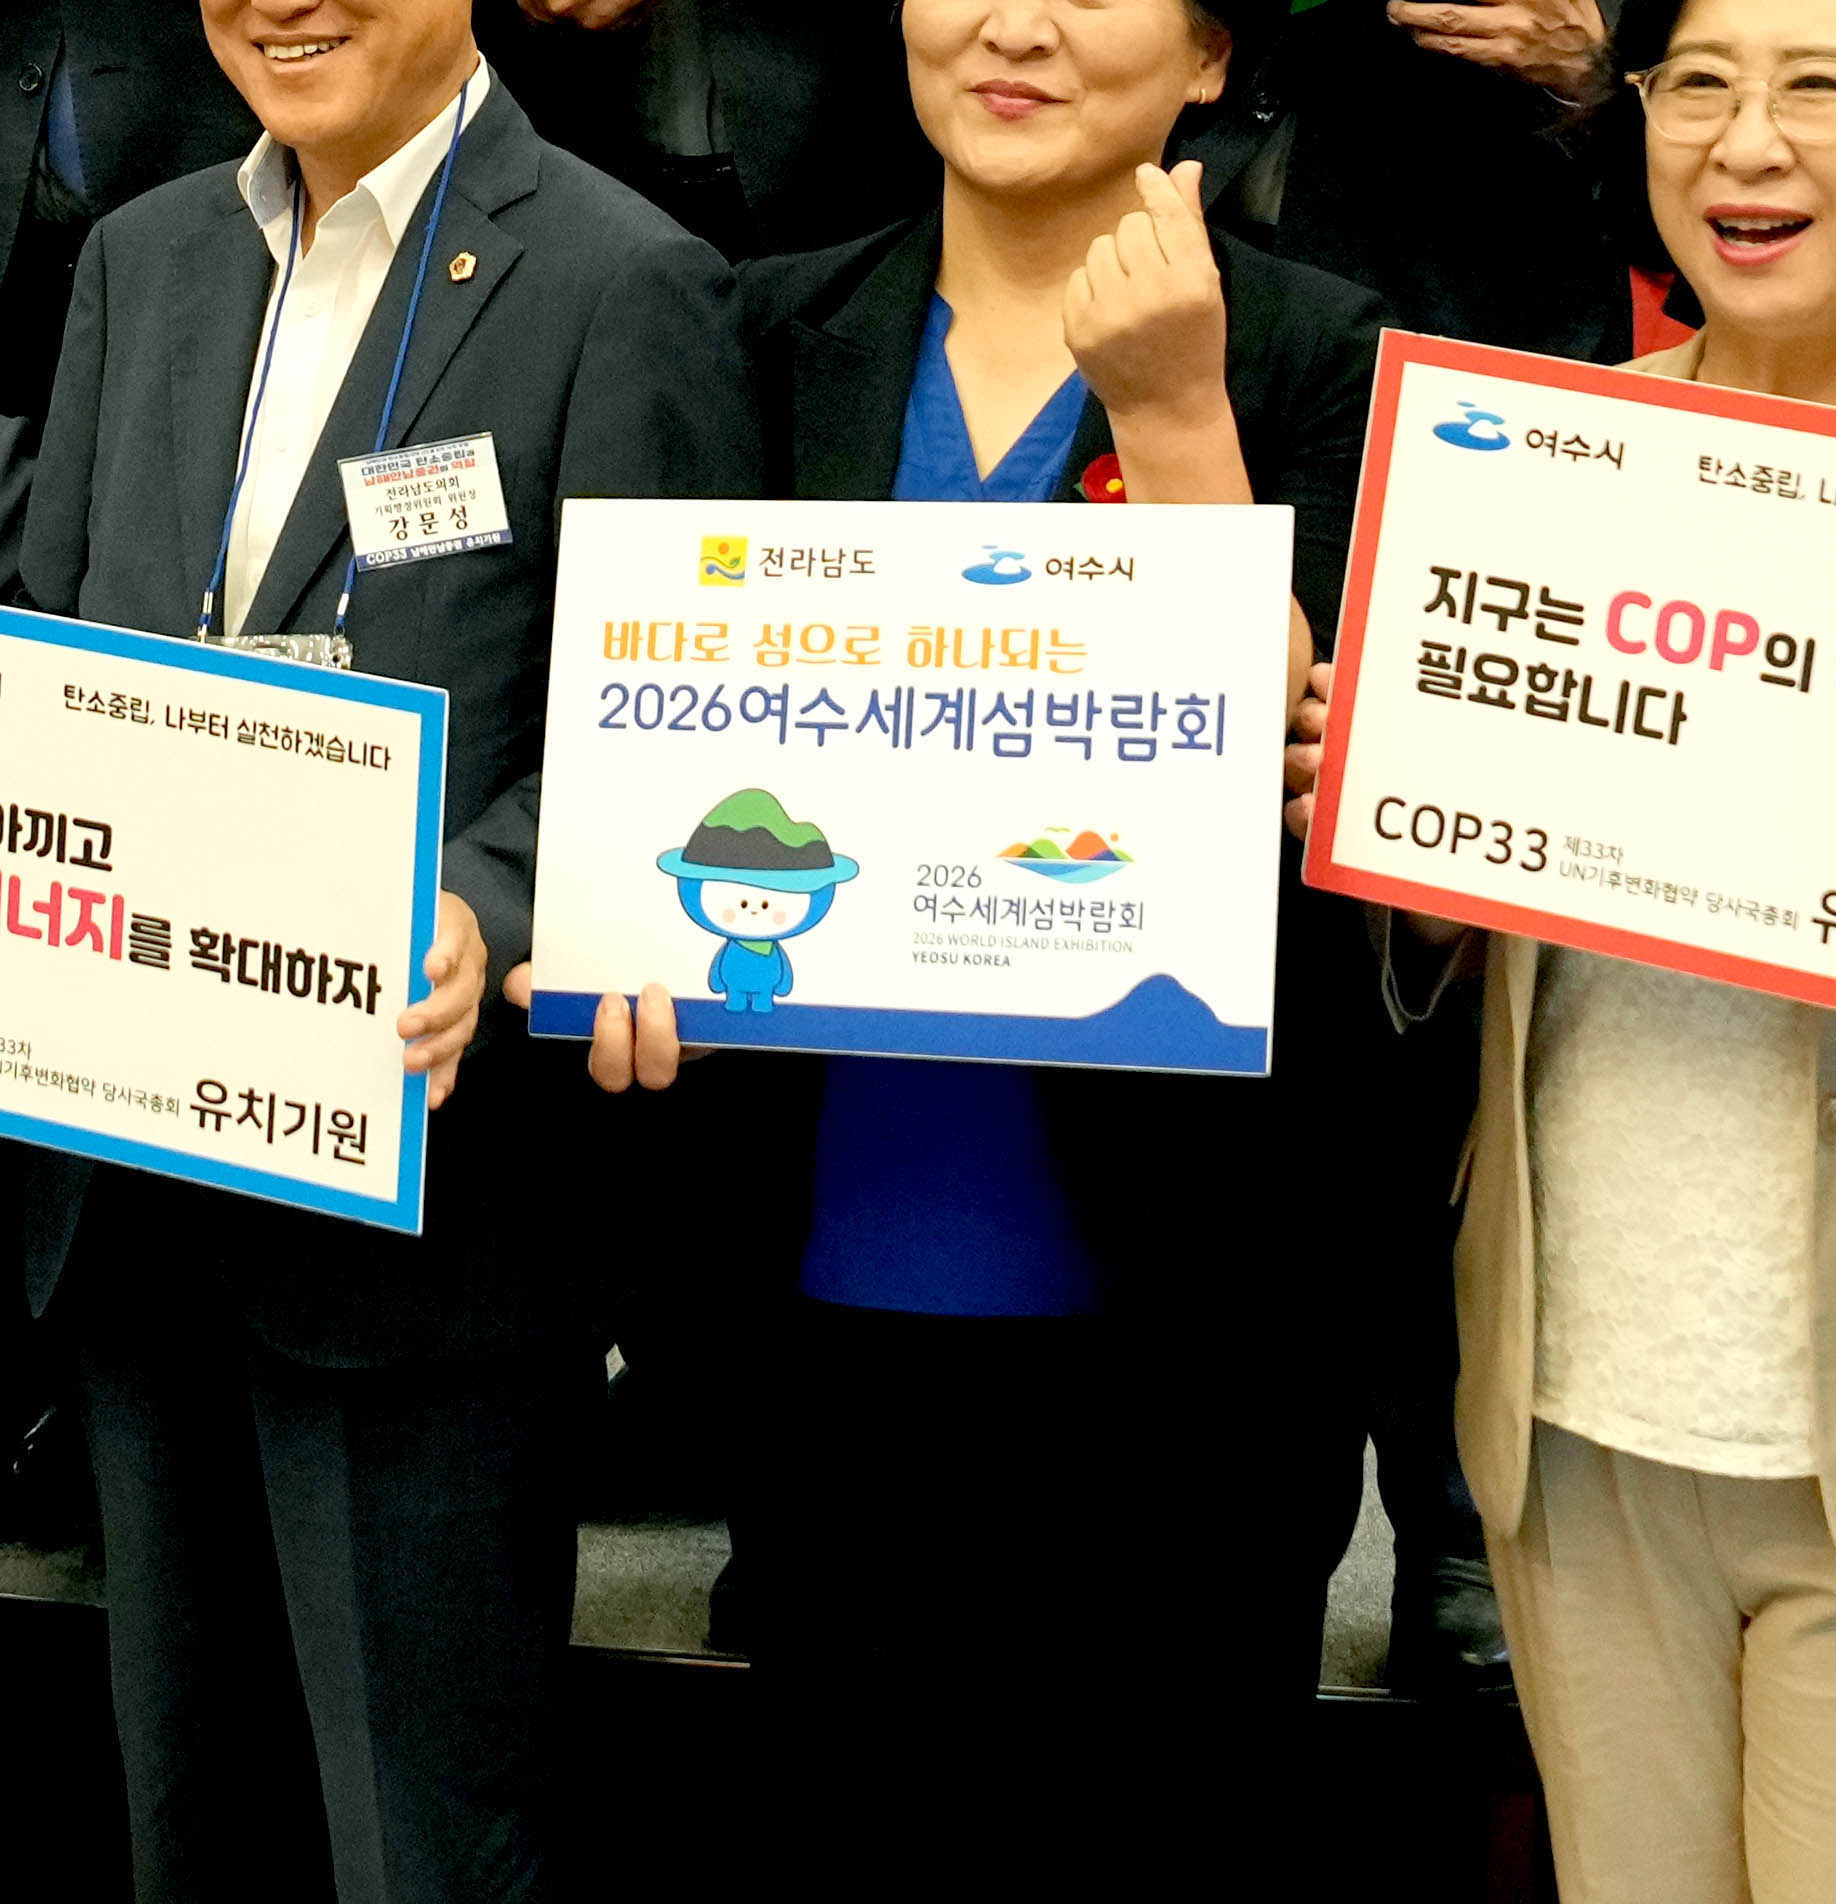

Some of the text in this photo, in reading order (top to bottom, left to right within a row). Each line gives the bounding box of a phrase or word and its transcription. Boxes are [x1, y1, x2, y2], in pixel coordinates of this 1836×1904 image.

[760, 547, 1133, 581] 전라남도 여수시
[604, 621, 1088, 674] 바다로 섬으로 하나되는
[1424, 566, 1584, 646] 지구는
[1606, 591, 1815, 693] COP의
[599, 683, 1225, 762] 2026여수세계섬박람회
[1418, 640, 1687, 745] 필요합니다
[1375, 797, 1547, 872] COP33
[189, 927, 382, 1015] 확대하자
[190, 1080, 367, 1165] 유치기원
